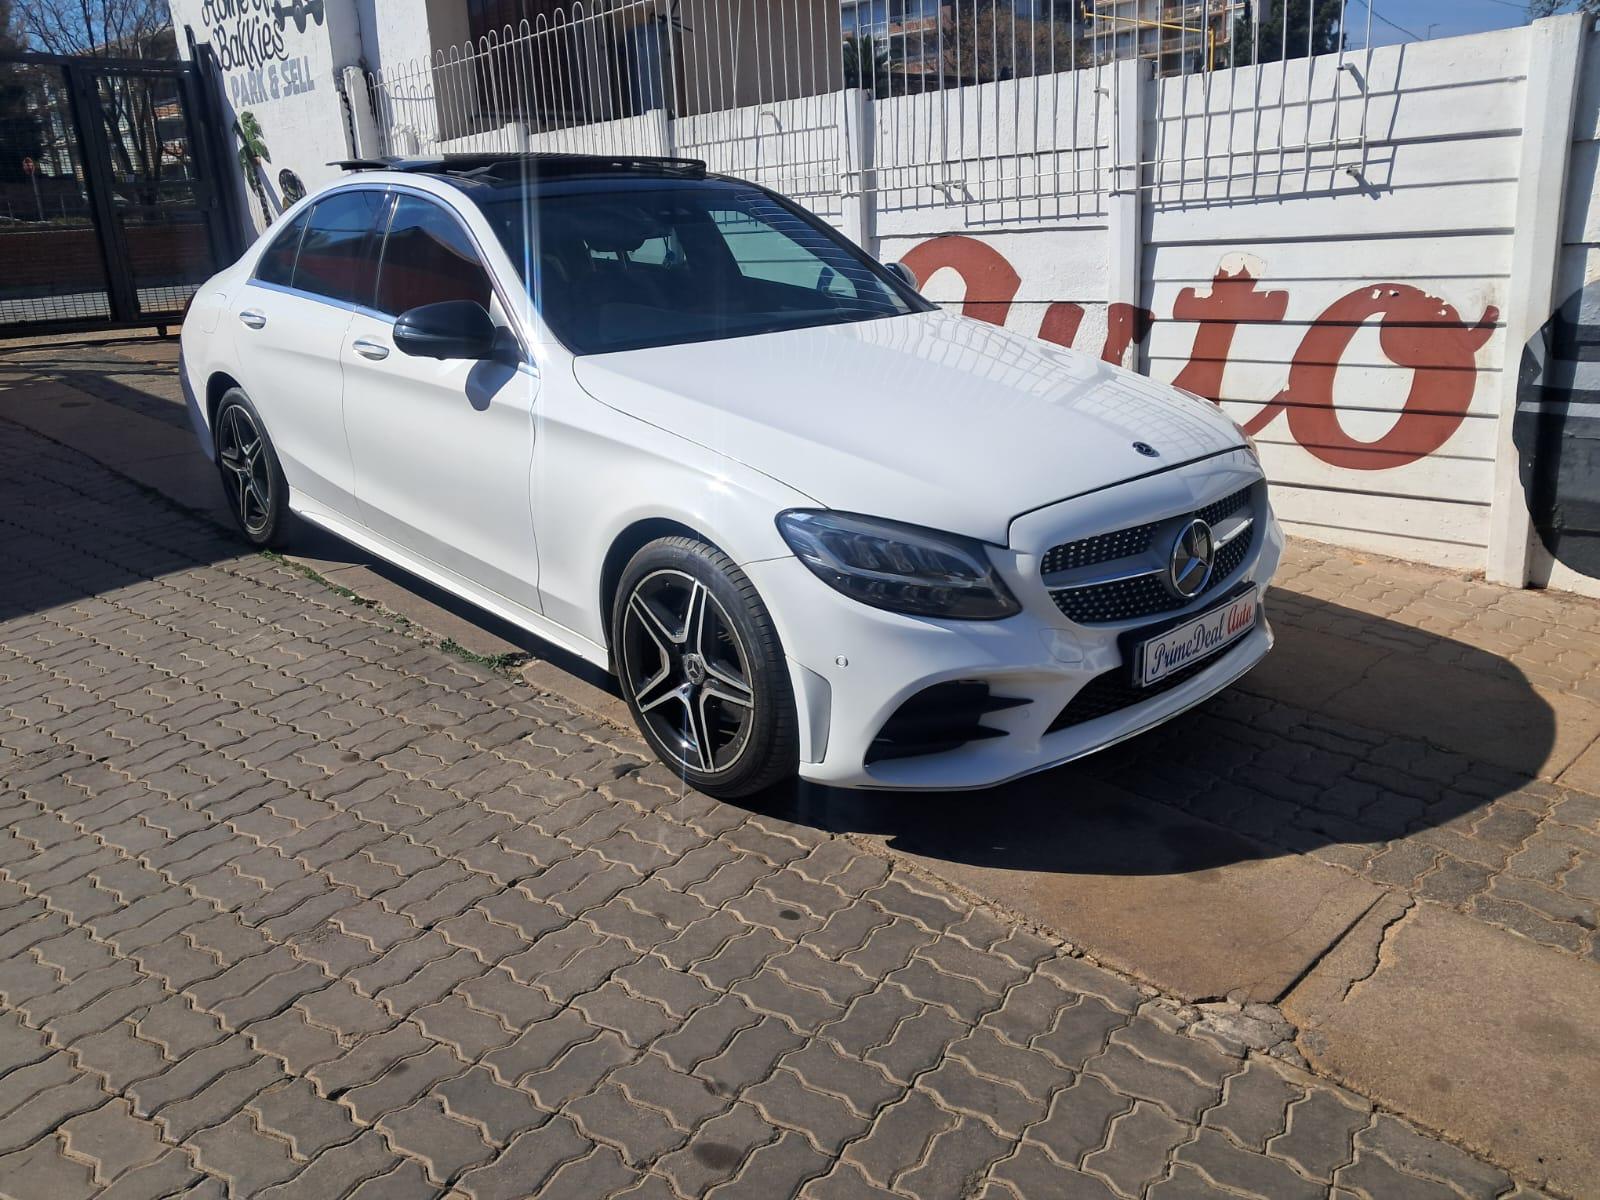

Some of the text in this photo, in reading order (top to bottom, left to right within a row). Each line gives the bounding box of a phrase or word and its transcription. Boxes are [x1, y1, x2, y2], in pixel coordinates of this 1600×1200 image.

[230, 56, 316, 109] PARK & SELL
[1227, 603, 1252, 635] Auto
